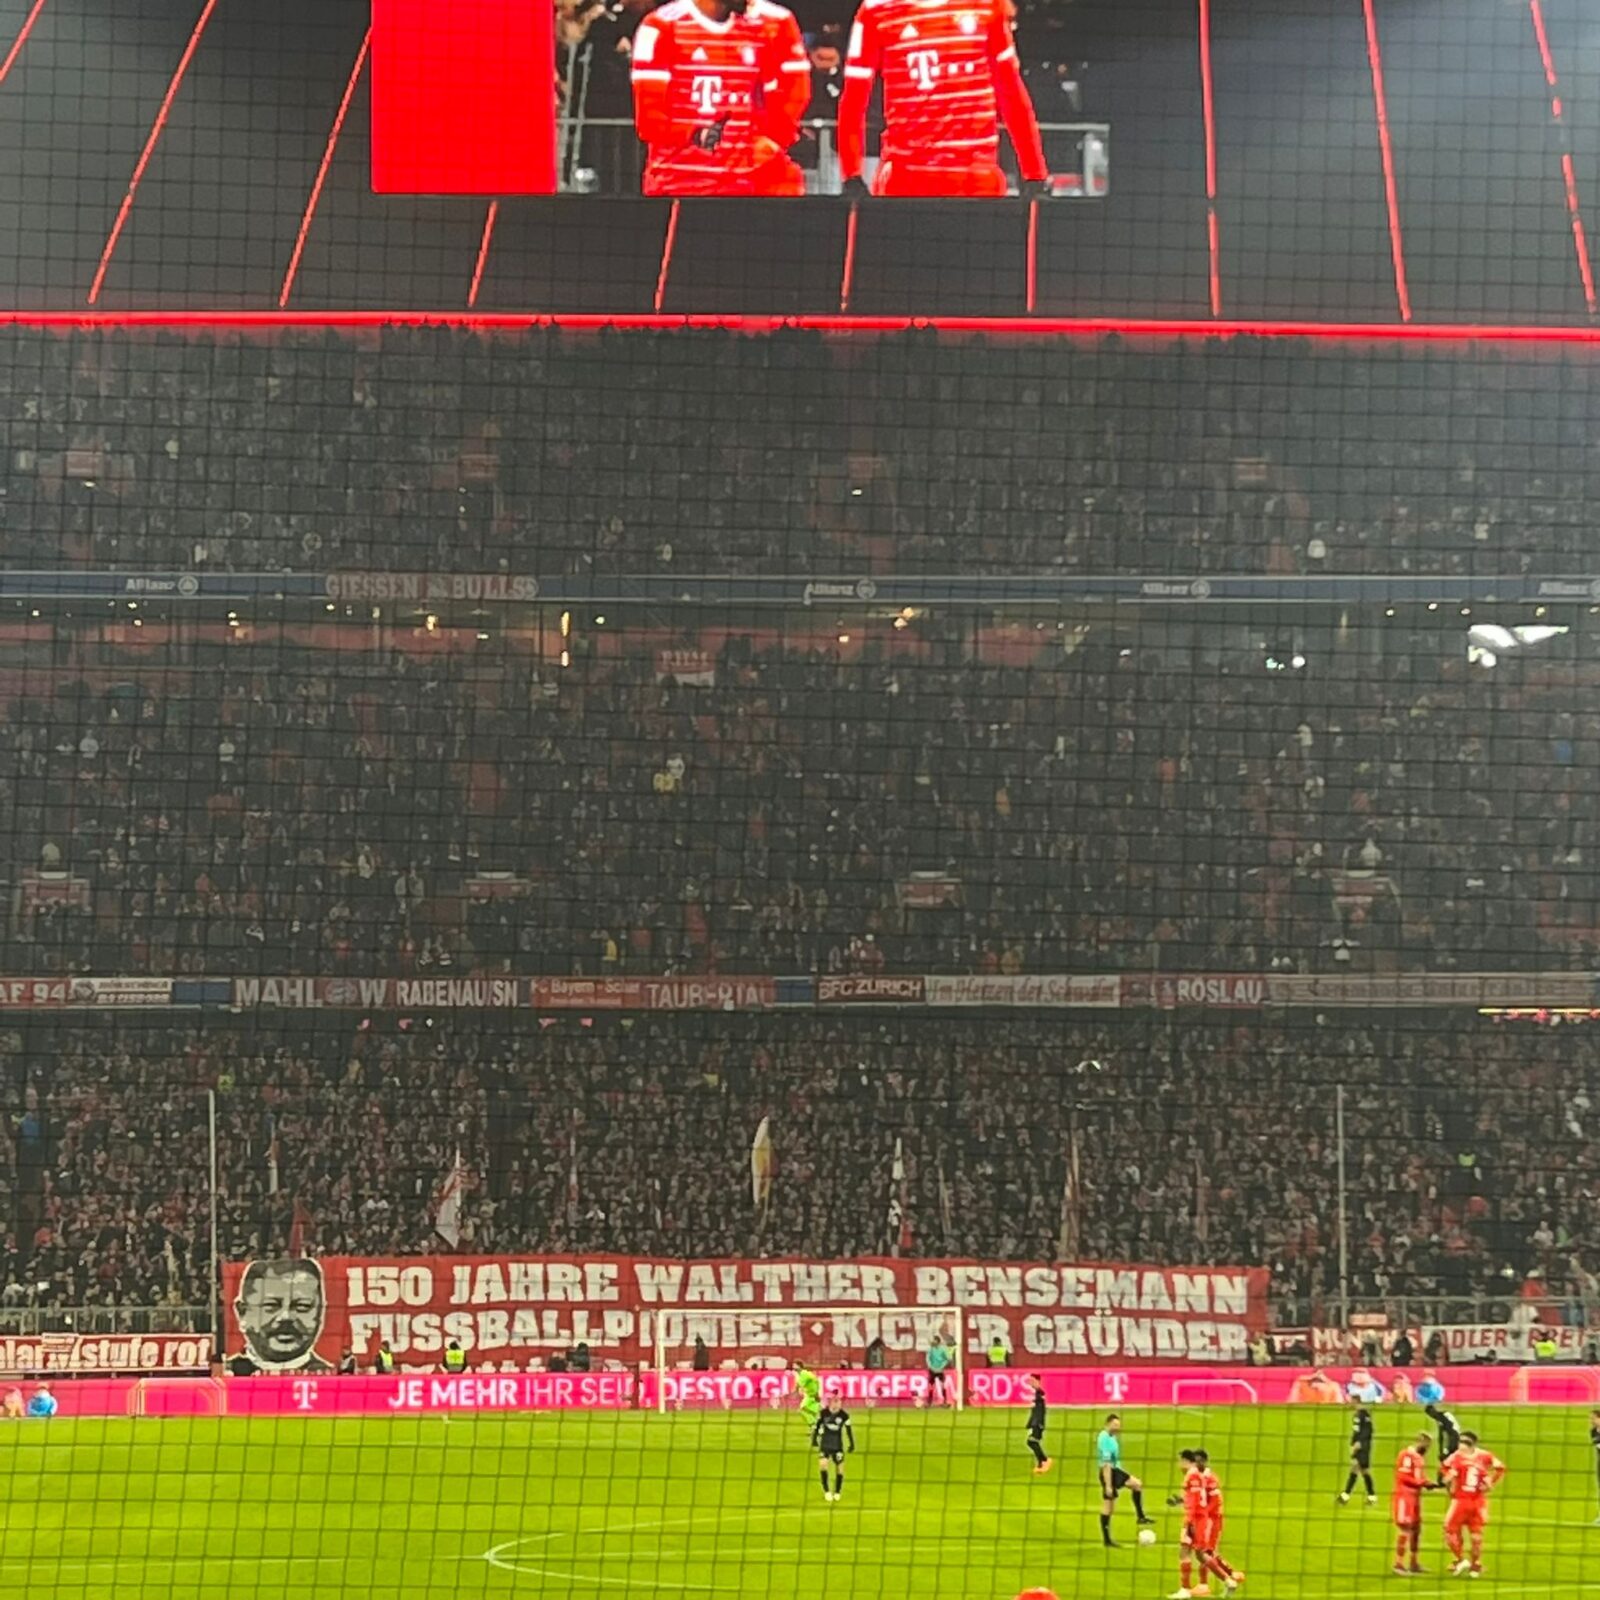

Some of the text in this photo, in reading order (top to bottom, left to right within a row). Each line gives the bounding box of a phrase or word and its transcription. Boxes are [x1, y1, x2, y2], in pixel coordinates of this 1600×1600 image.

[33, 983, 66, 1003] 94
[346, 1263, 1248, 1316] 150 JAHRE WALTHER BENSEMANN
[350, 1310, 809, 1354] FUSSBALLPIONIER
[1024, 1307, 1245, 1361] GRÜNDER
[165, 1338, 211, 1367] rot
[389, 1378, 424, 1407] JE
[430, 1378, 518, 1407] MEHR
[525, 1377, 574, 1406] IHR
[761, 1375, 928, 1399] GSTIGER
